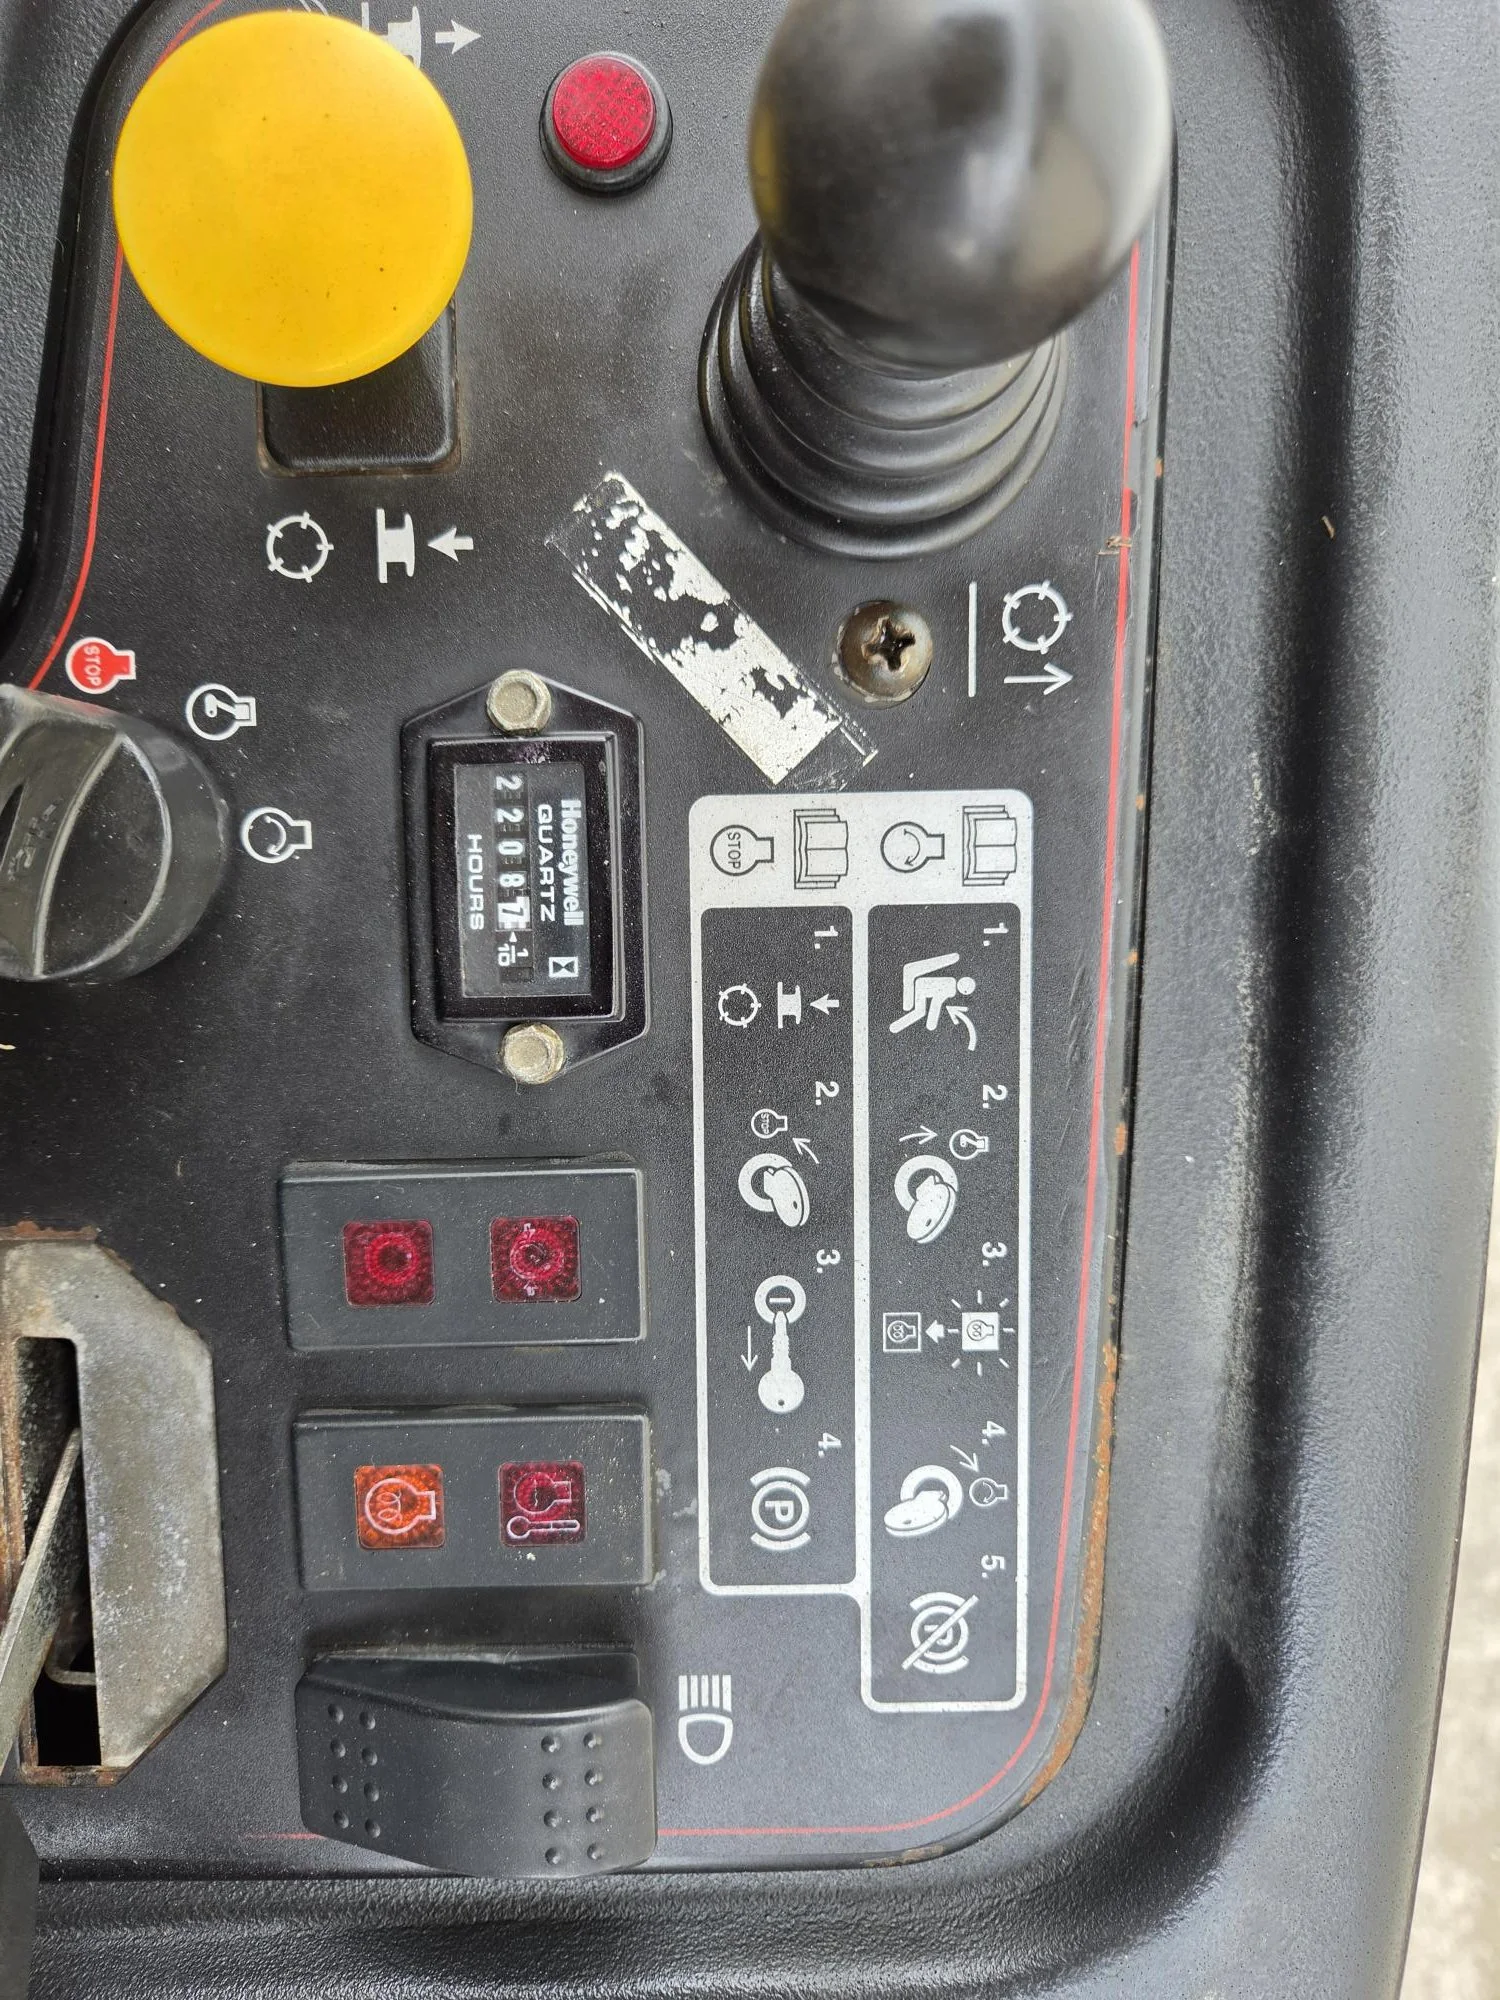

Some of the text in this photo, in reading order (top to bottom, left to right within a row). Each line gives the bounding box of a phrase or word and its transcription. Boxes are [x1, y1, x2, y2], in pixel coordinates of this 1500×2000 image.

[84, 644, 102, 686] STOP
[537, 803, 556, 922] QUARTZ
[557, 799, 584, 926] Honeywell
[727, 831, 742, 870] STOP
[467, 833, 485, 931] HOURS
[814, 925, 839, 950] 1.
[983, 921, 1008, 947] 1.
[815, 1080, 840, 1106] 2.
[982, 1084, 1008, 1109] 2.
[760, 1112, 771, 1135] STOP
[816, 1248, 841, 1274] 3.
[982, 1241, 1007, 1267] 3.
[817, 1432, 842, 1459] 4.
[981, 1420, 1006, 1445] 4.
[981, 1554, 1005, 1578] 5.
